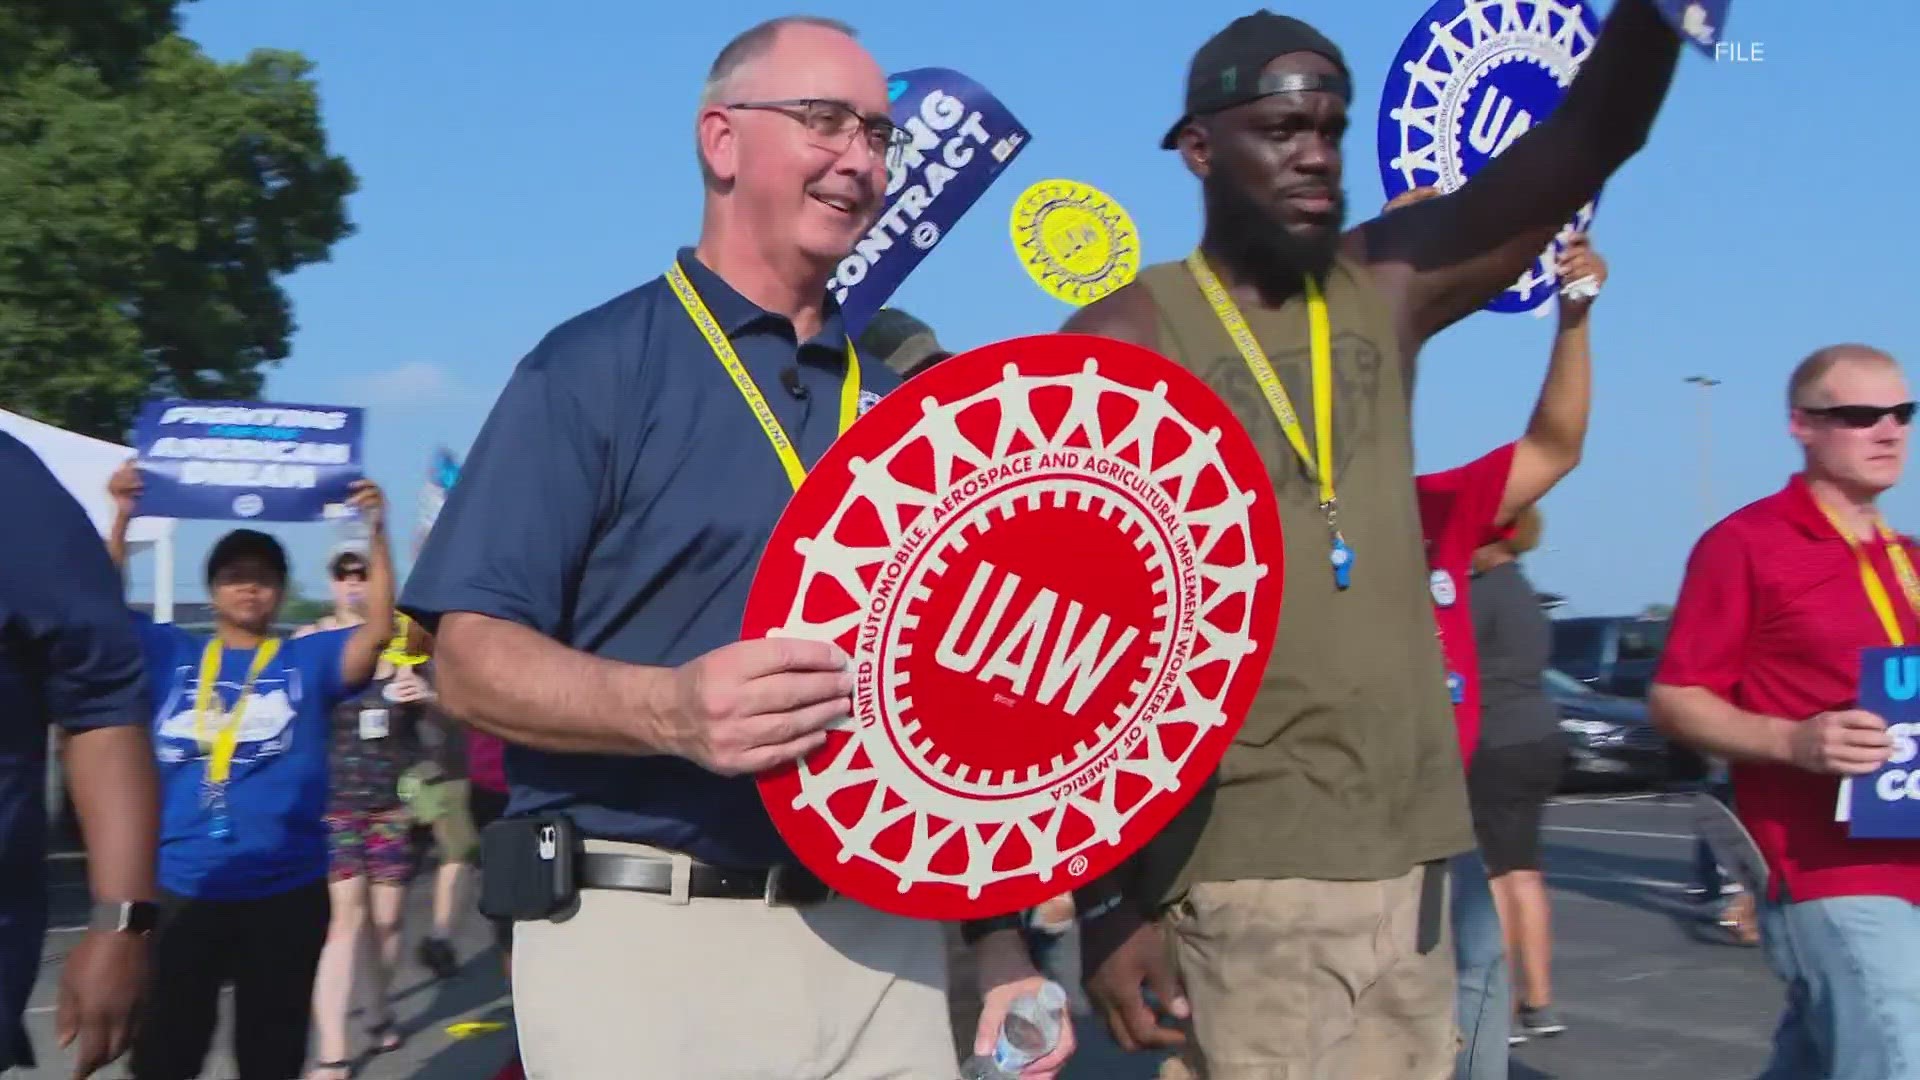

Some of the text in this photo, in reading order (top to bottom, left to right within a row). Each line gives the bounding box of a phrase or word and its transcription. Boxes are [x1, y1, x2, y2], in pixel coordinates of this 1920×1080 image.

[858, 452, 1197, 801] UNITED AUTOMOBILE, AEROSPACE AND AGRICULTURAL IMPLEMENT WORKERS OF AMERICA
[935, 560, 1140, 716] UAW
[1884, 656, 1920, 700] U
